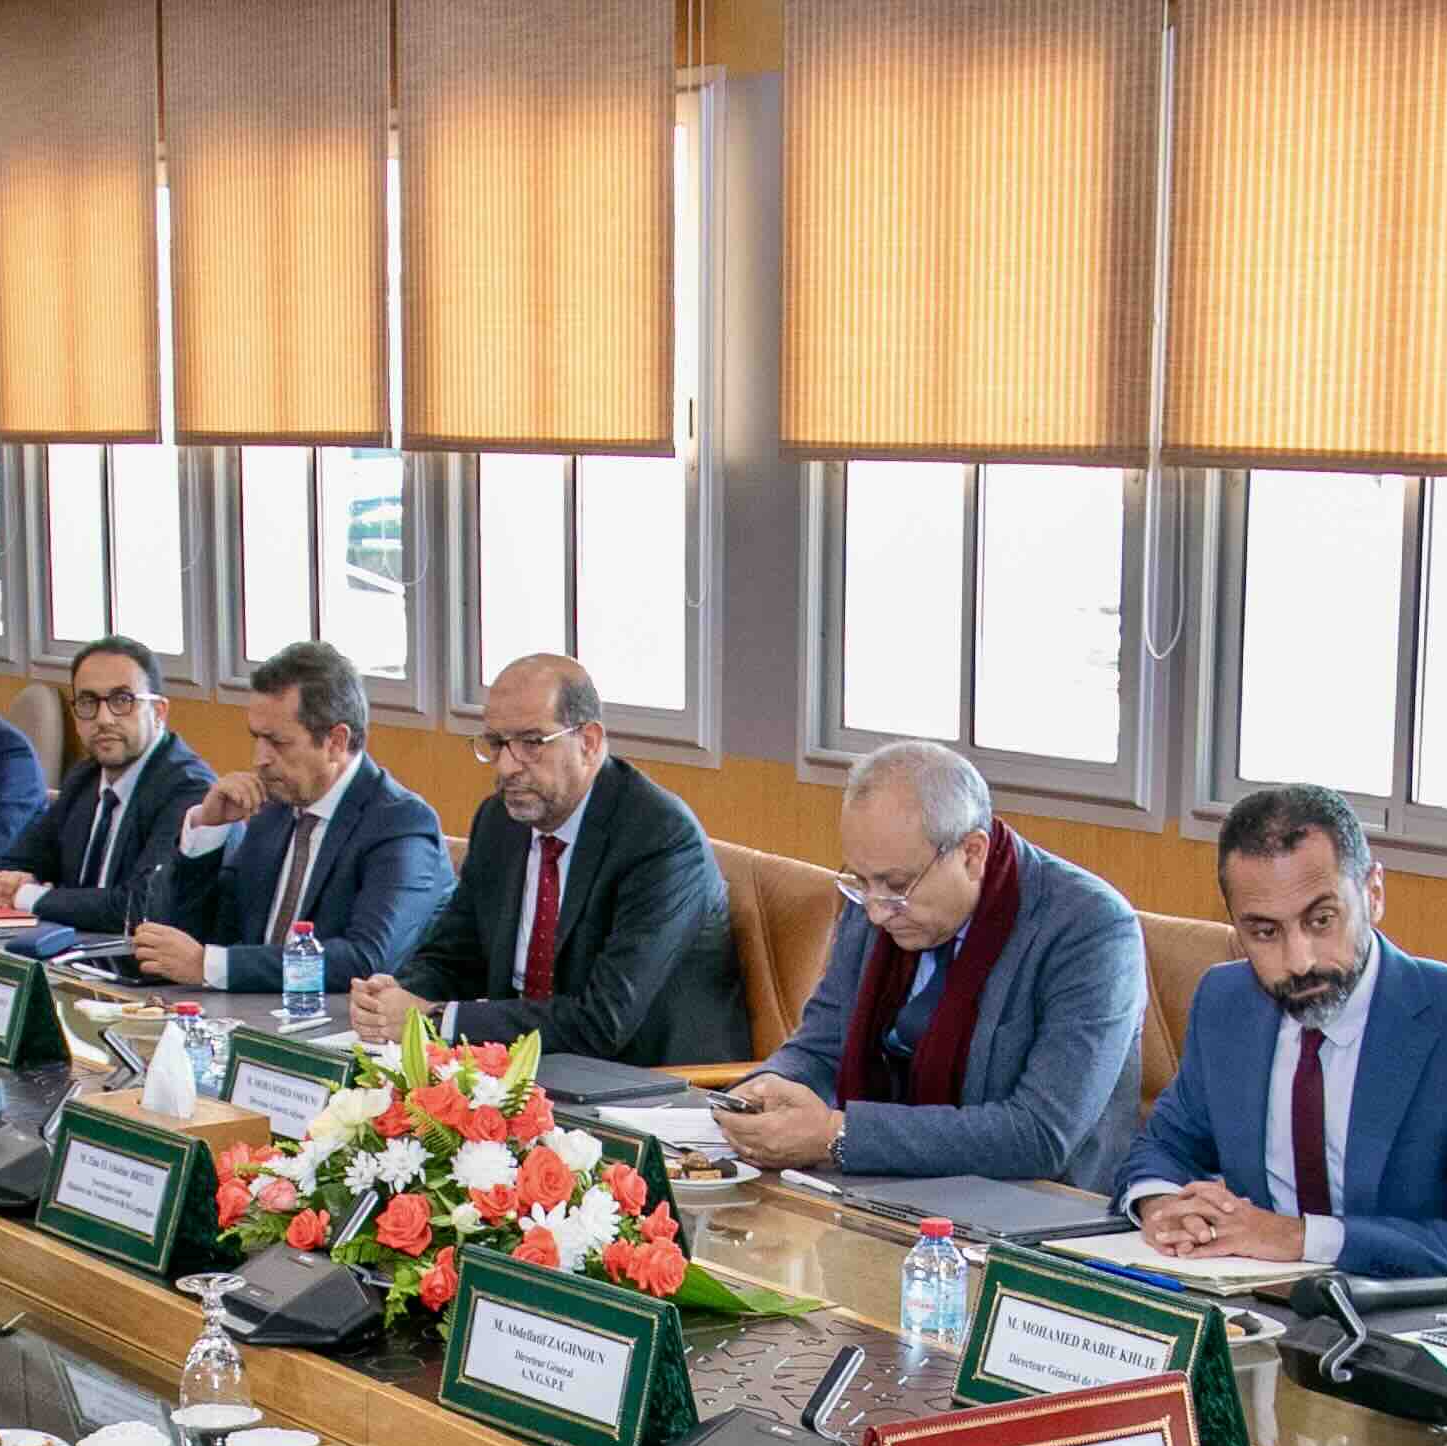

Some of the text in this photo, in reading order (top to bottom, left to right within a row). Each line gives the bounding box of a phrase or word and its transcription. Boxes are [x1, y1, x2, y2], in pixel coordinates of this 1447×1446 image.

[492, 1317, 505, 1332] M.
[547, 1337, 606, 1364] ZAGHNOUN
[1007, 1314, 1018, 1330] M.
[1020, 1320, 1080, 1348] MOHAMED
[1082, 1335, 1117, 1358] RABIE
[1008, 1352, 1046, 1371] Directeur
[1047, 1362, 1081, 1383] Général
